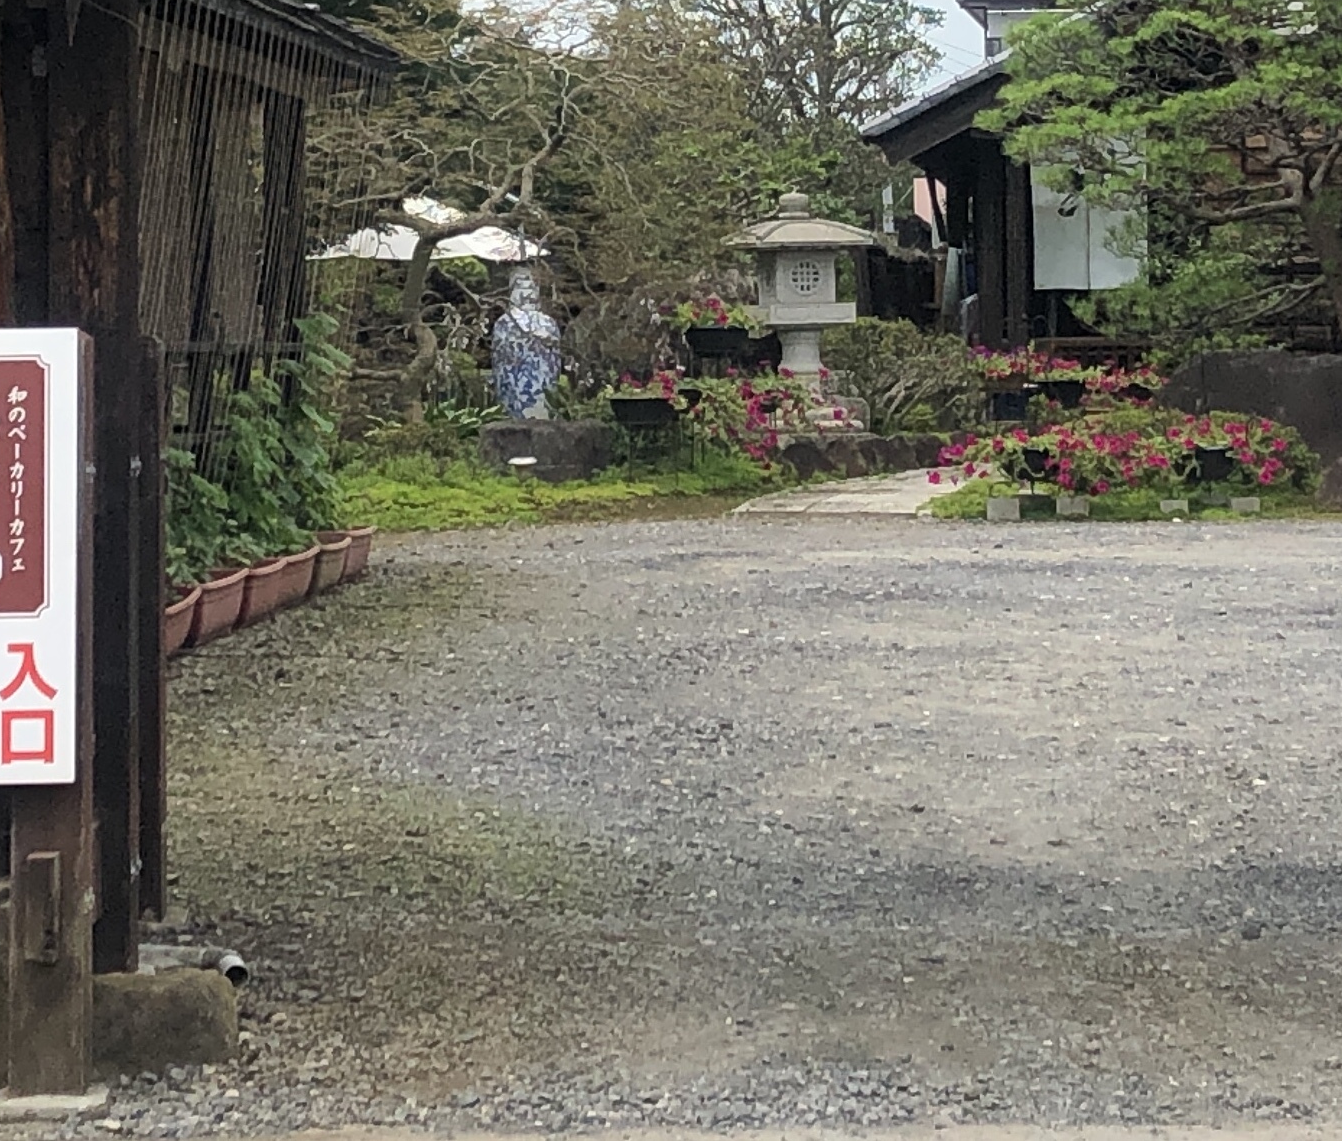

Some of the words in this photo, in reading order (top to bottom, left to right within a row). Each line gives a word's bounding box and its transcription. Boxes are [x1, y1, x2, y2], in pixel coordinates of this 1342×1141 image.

[7, 385, 28, 572] 和のベーカリーカフェ
